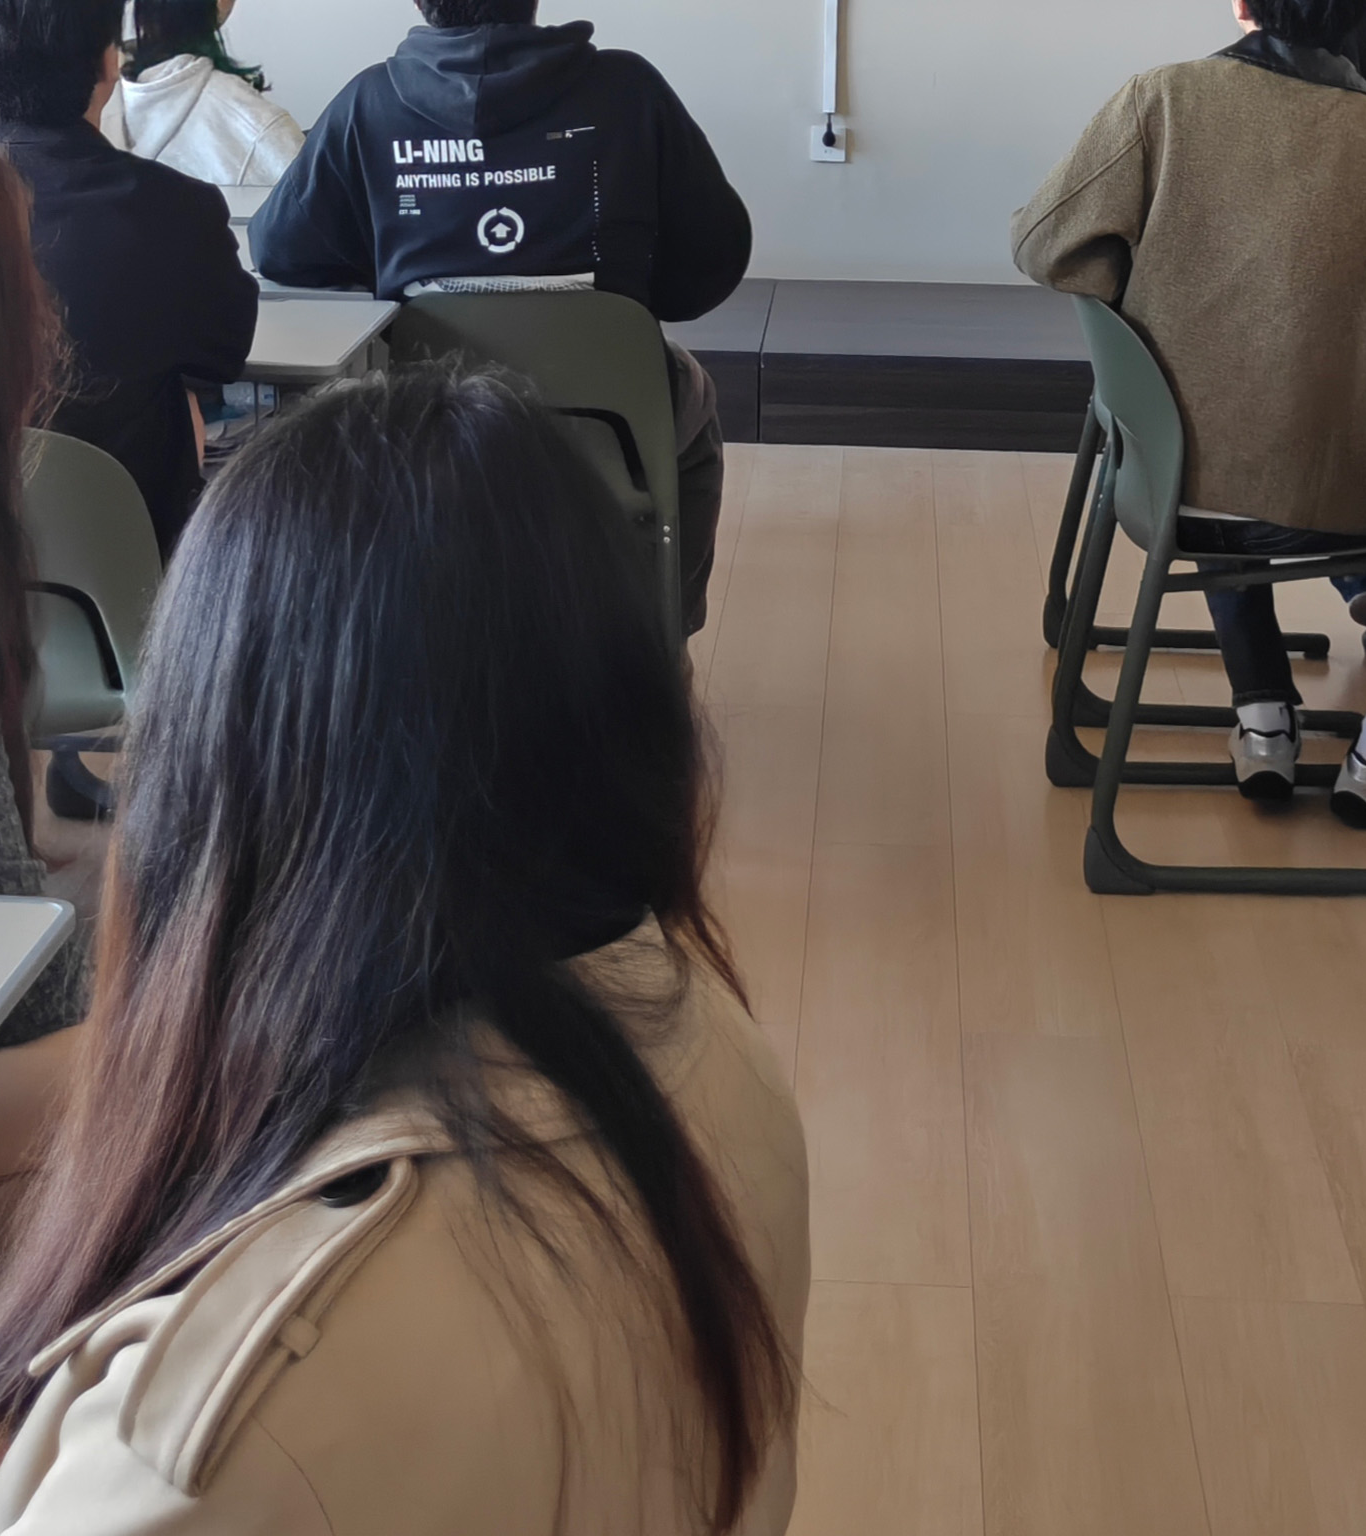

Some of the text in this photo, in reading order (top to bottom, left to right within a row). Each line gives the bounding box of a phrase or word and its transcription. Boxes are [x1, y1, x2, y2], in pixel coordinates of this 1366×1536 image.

[393, 139, 484, 164] LI-NING
[396, 165, 556, 189] ANYTHING IS POSSIBLE
